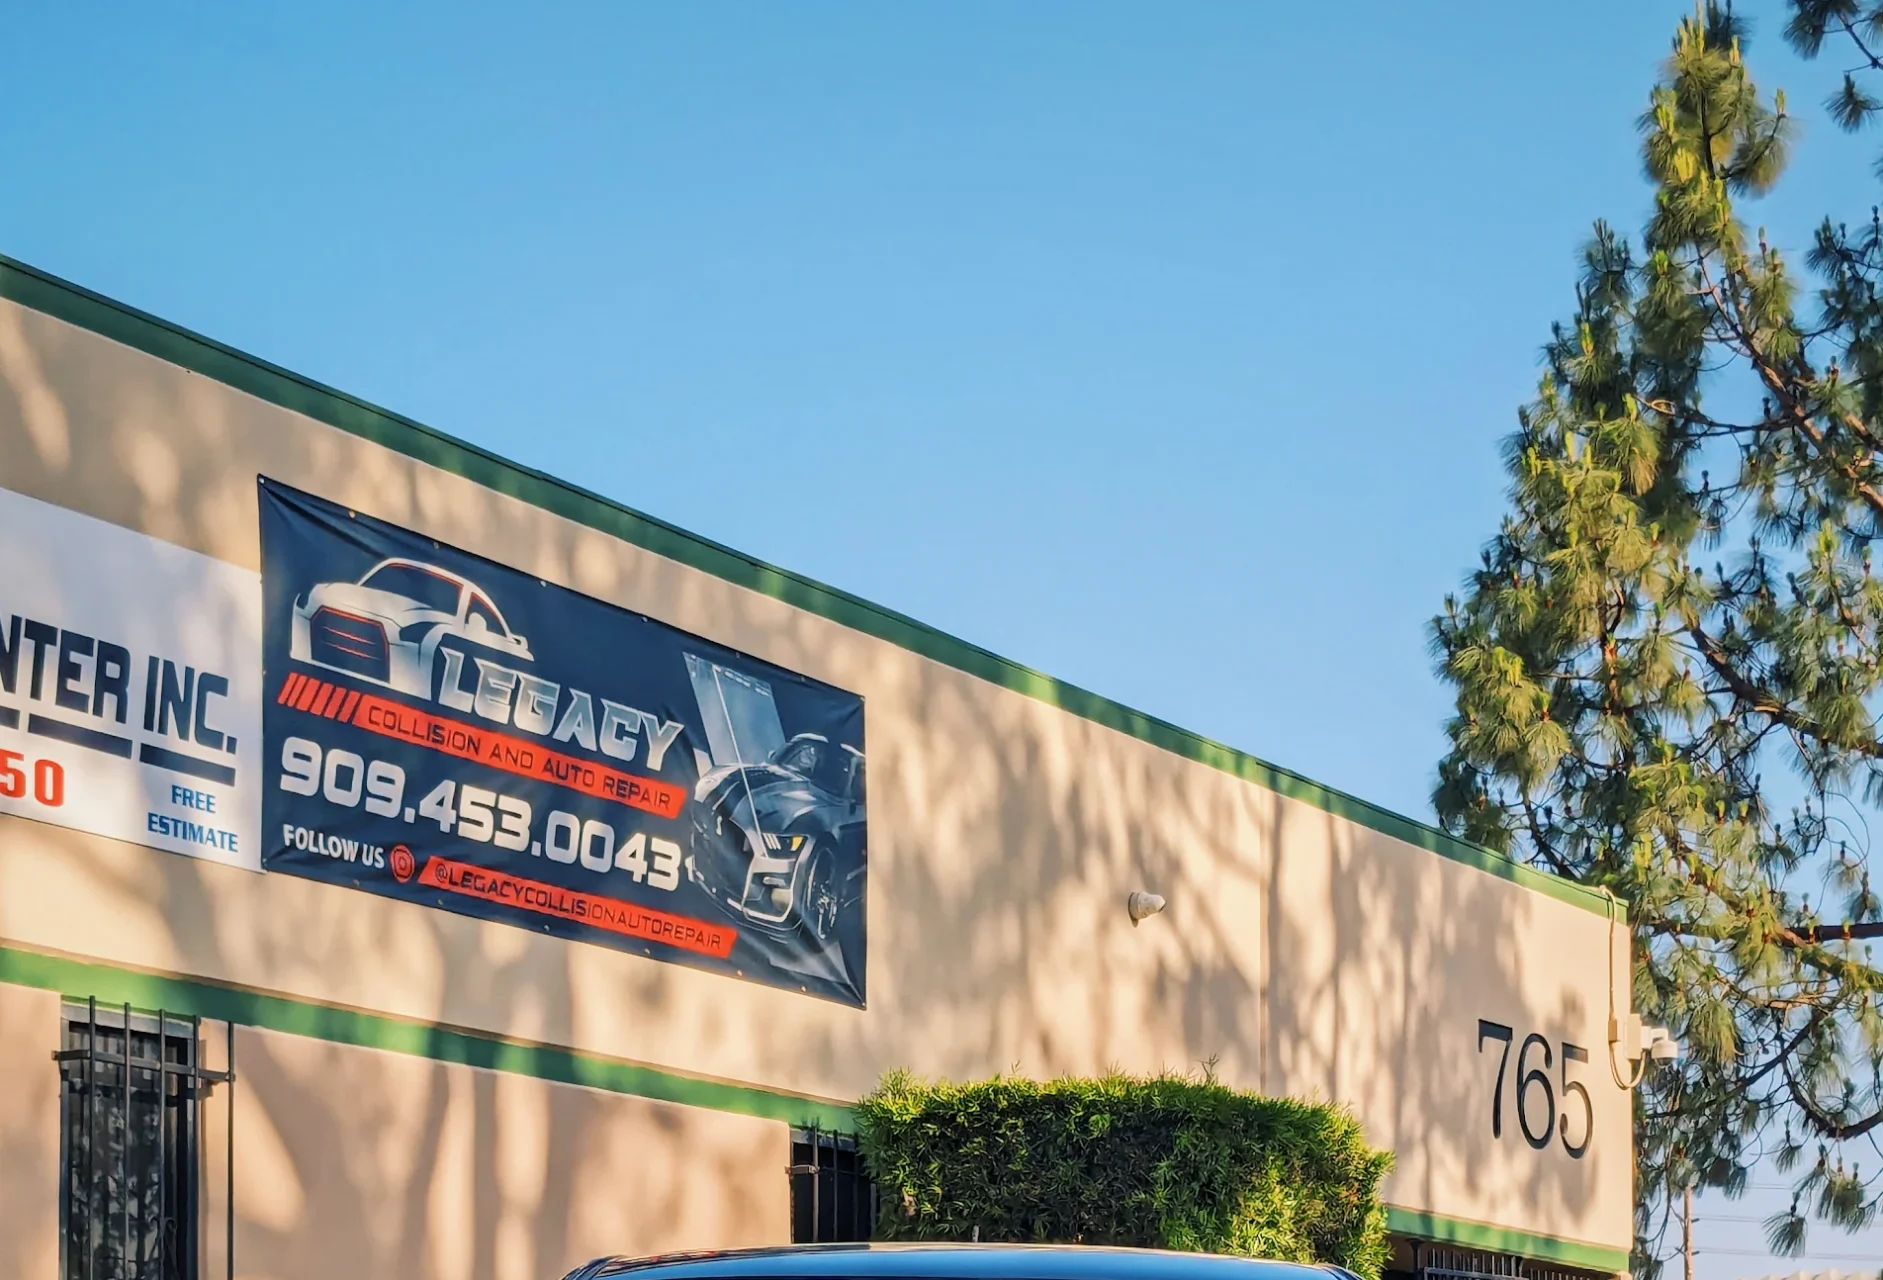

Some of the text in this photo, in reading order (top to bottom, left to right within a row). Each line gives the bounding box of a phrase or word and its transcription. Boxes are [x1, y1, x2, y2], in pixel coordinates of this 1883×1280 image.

[143, 655, 237, 755] INC.
[438, 646, 685, 771] LEGACY
[171, 784, 216, 814] FREE
[368, 705, 671, 811] COLLISION AND AUTO REPAIR
[147, 812, 239, 853] ESTIMATE
[280, 736, 682, 892] 909.453.0043
[283, 824, 385, 869] FOLLOW US
[435, 863, 721, 950] @LEGACYCOLLISIONAUTOREPAIR
[1478, 1018, 1593, 1159] 765
